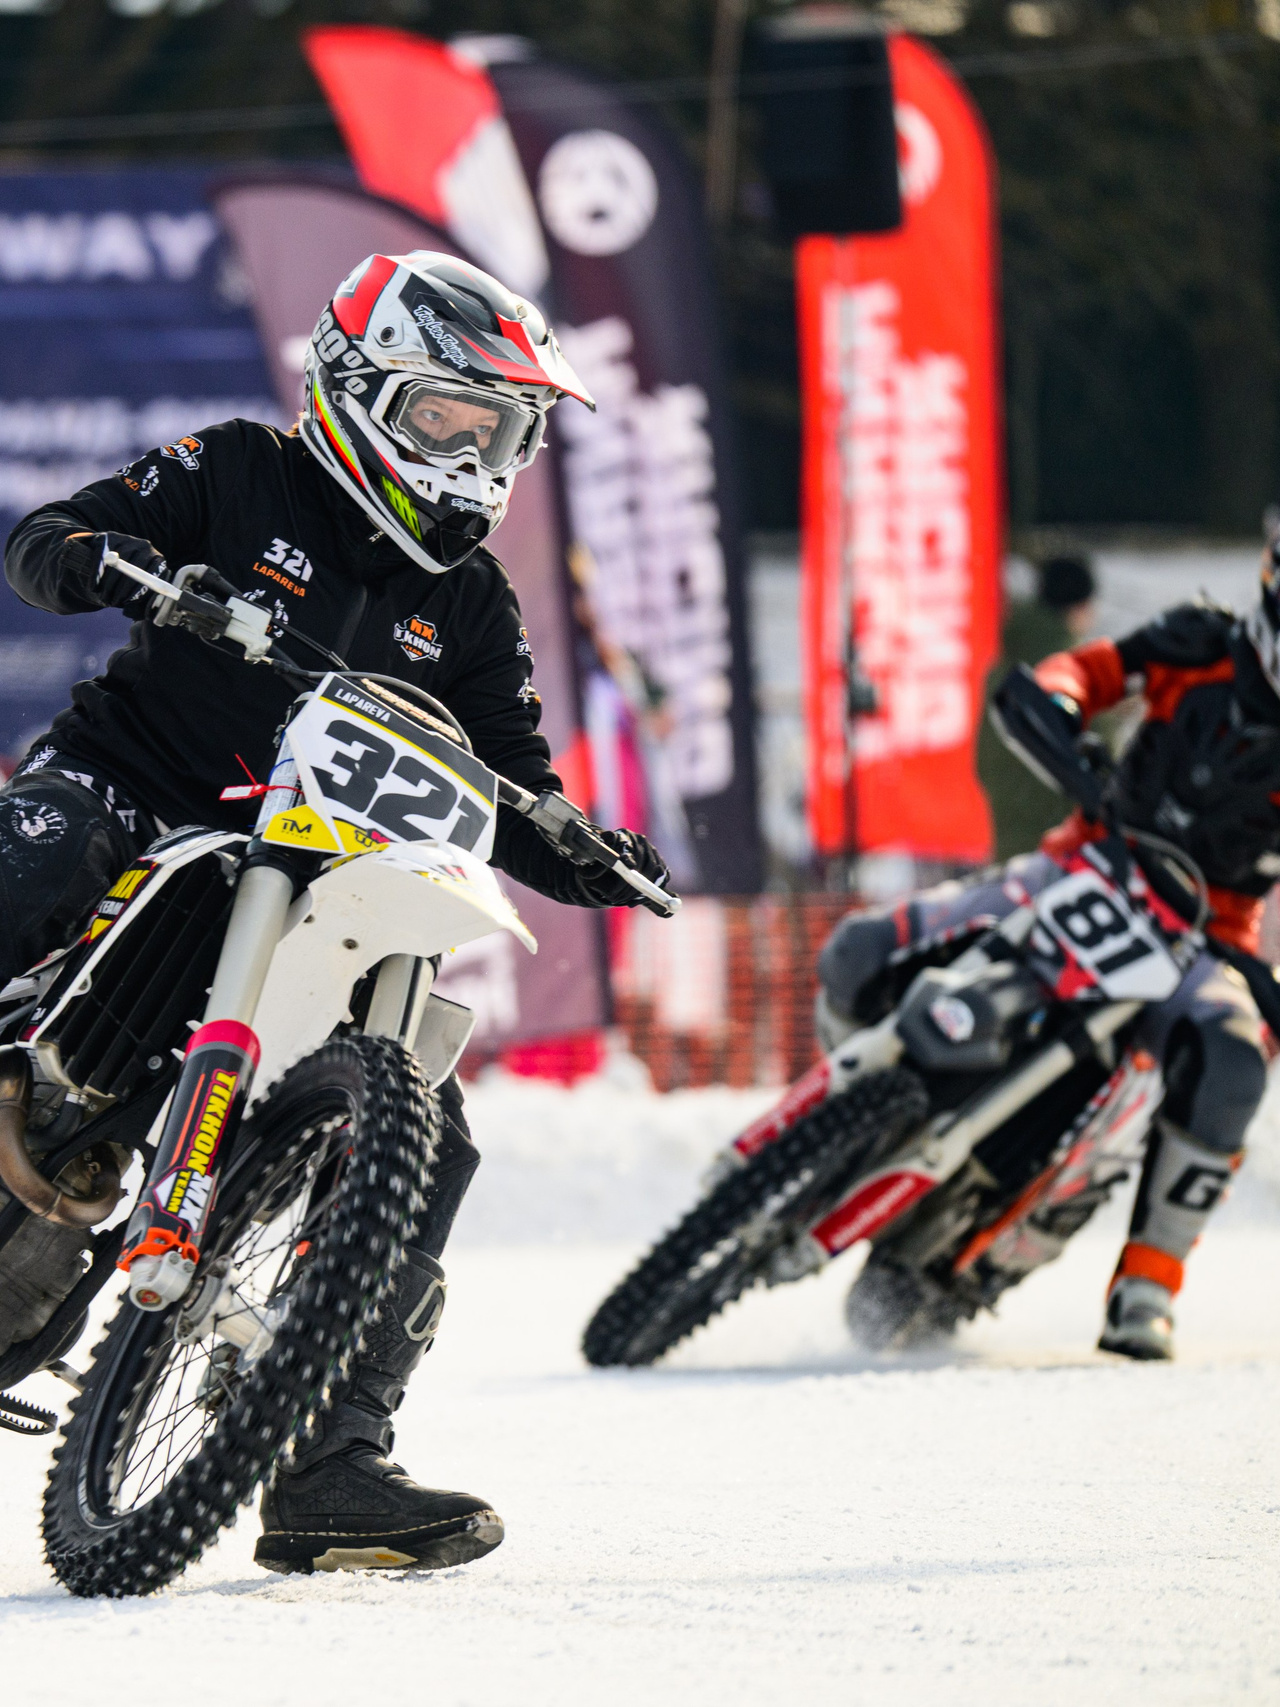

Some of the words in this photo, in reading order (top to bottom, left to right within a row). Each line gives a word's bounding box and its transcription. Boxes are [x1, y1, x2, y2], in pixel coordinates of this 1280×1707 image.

[252, 562, 306, 597] LAPAREVA
[263, 537, 313, 582] 321
[410, 618, 434, 641] MX
[334, 688, 391, 723] LAPAREVA
[310, 719, 489, 852] 321
[1052, 889, 1155, 977] 81
[186, 1071, 238, 1177] TIKHON
[167, 1170, 193, 1213] TEAM
[178, 1171, 214, 1232] MX
